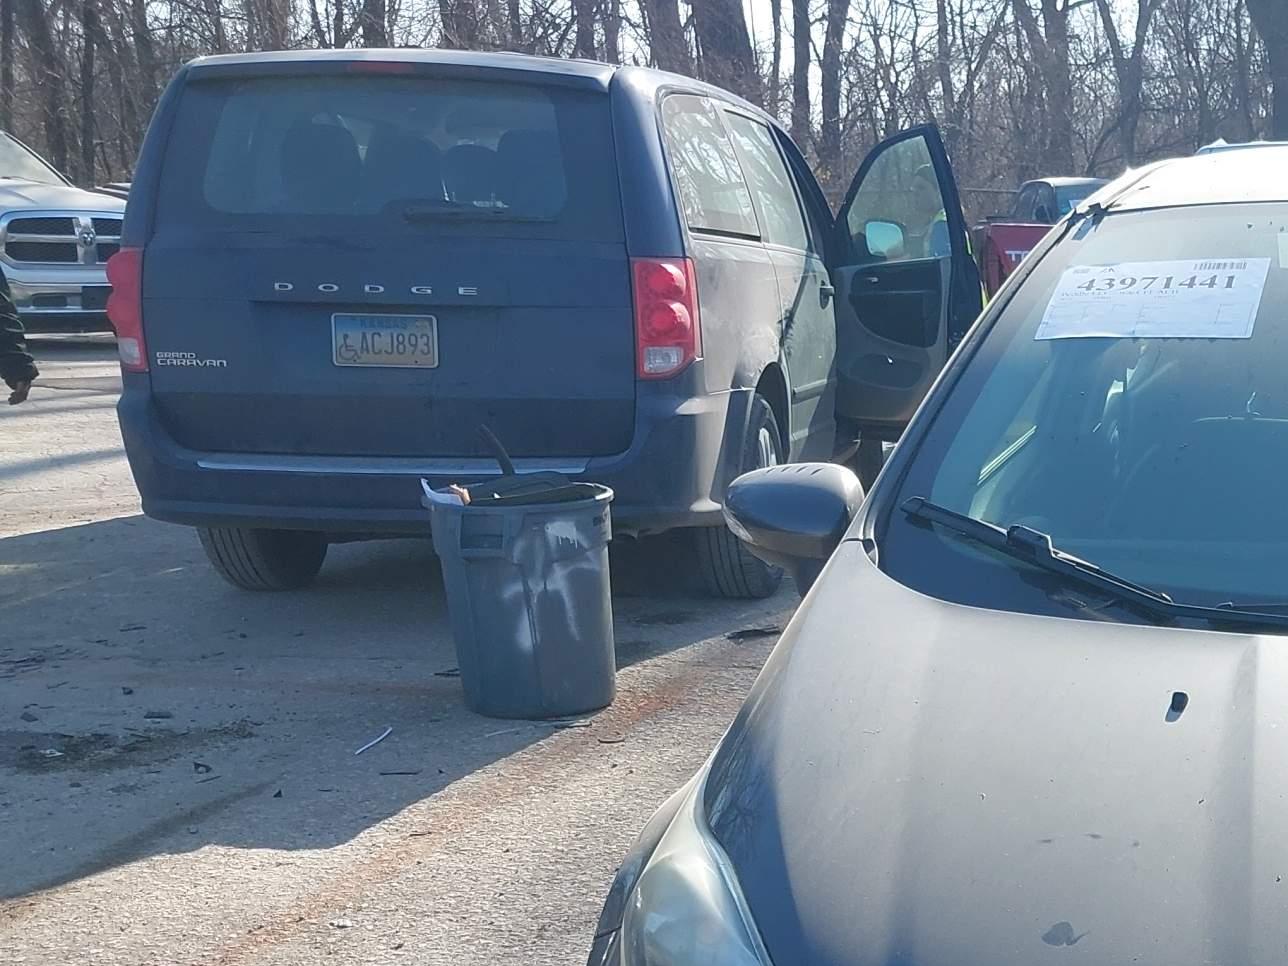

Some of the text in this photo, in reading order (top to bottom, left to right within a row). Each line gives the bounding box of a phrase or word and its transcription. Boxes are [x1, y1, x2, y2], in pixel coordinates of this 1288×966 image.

[274, 282, 478, 296] DODGE
[1077, 274, 1236, 291] 43971441
[360, 332, 431, 356] ACJ893
[156, 358, 227, 367] CARAVAN
